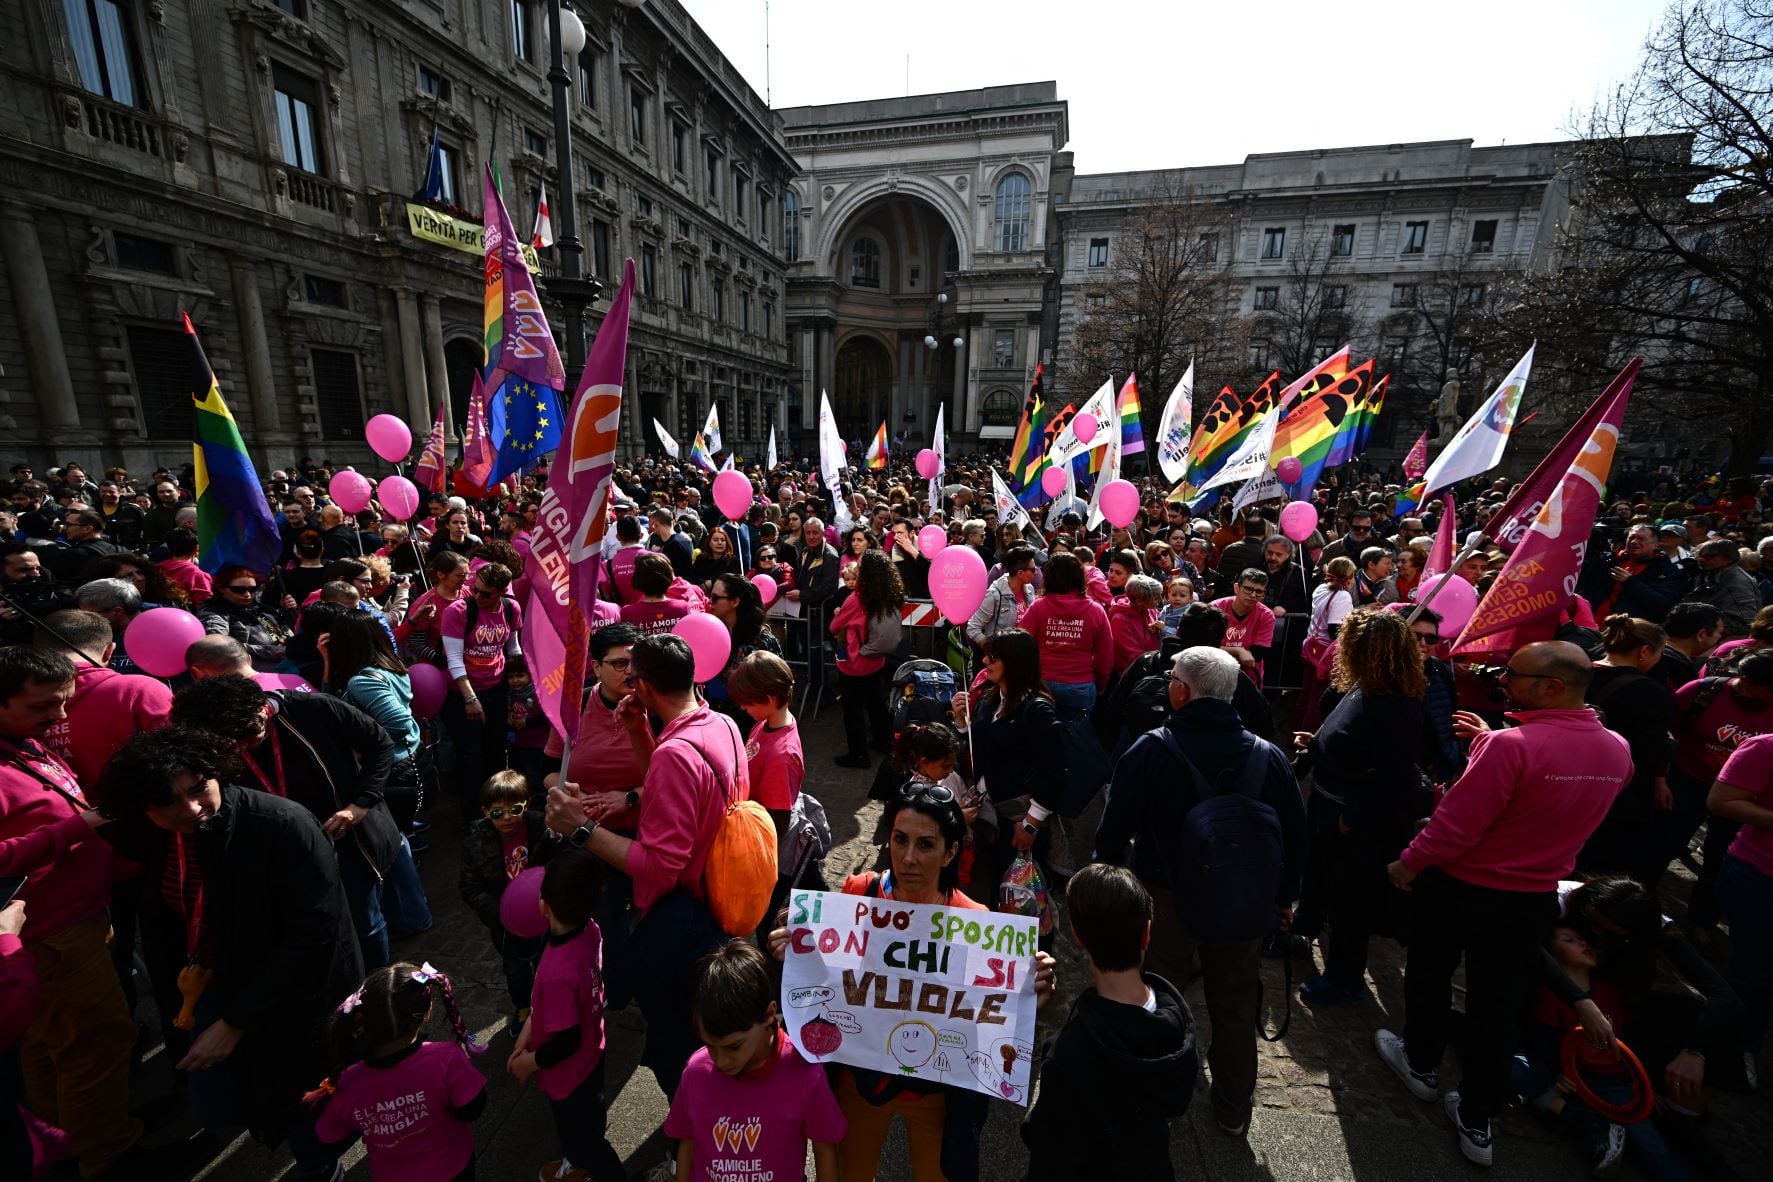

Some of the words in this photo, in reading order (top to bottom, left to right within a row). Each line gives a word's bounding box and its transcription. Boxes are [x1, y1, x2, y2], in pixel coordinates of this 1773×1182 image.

[413, 212, 456, 241] VERITÀ
[458, 227, 478, 248] PER
[1046, 630, 1081, 639] FAMIGLIA
[930, 911, 1037, 957] SPOSARE
[790, 927, 870, 957] CON
[883, 940, 951, 974] CHI
[972, 957, 1017, 990] SI
[842, 968, 1008, 1026] VUOLE
[379, 1110, 404, 1124] CREA
[404, 1103, 428, 1115] UNA
[710, 1159, 763, 1173] FAMIGLIE
